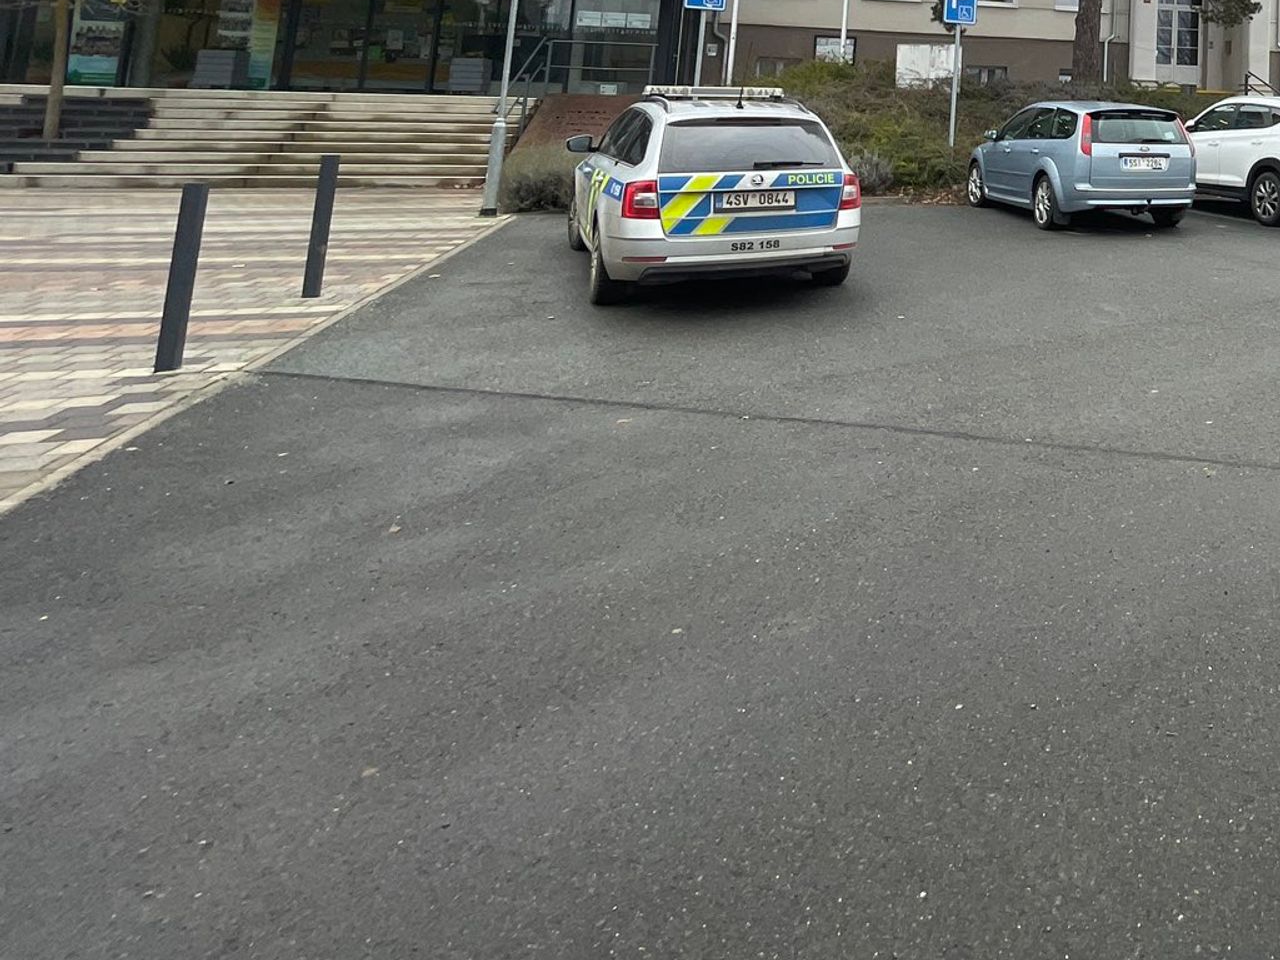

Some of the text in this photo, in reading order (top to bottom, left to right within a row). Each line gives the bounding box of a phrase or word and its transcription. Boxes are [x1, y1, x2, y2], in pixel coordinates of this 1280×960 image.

[788, 173, 835, 184] POLICIE
[726, 192, 789, 206] 4SV 0844
[731, 240, 780, 251] S82 158
